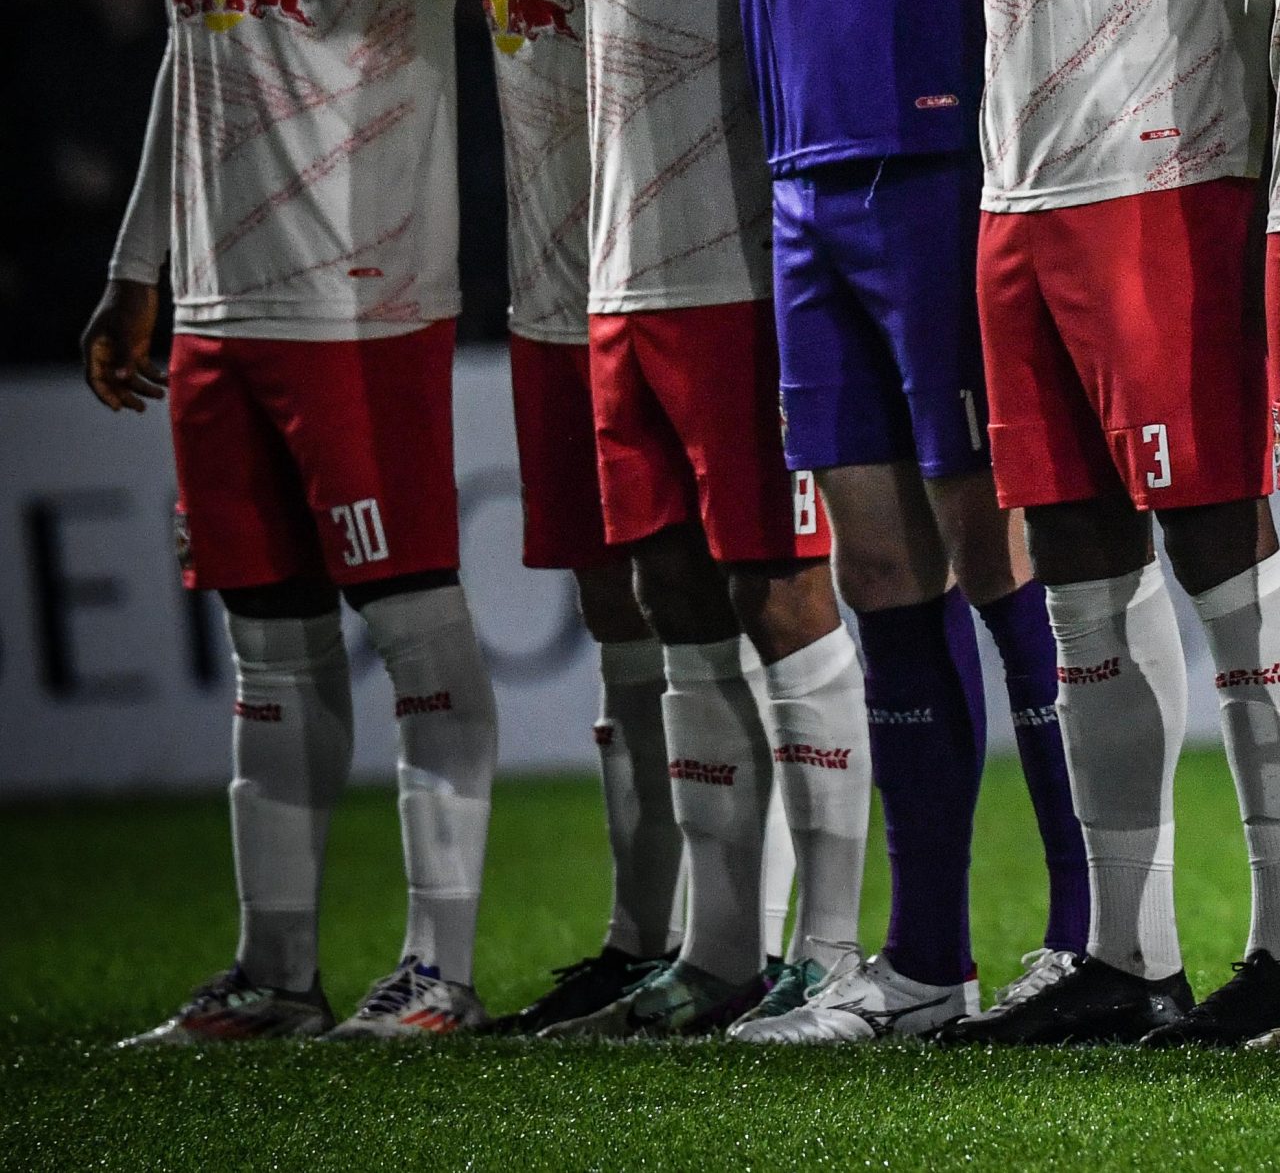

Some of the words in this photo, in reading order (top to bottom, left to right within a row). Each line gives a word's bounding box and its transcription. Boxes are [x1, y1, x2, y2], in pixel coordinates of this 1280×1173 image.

[960, 389, 982, 451] 1
[1142, 424, 1171, 489] 3
[331, 497, 389, 566] 30
[792, 470, 816, 535] 8
